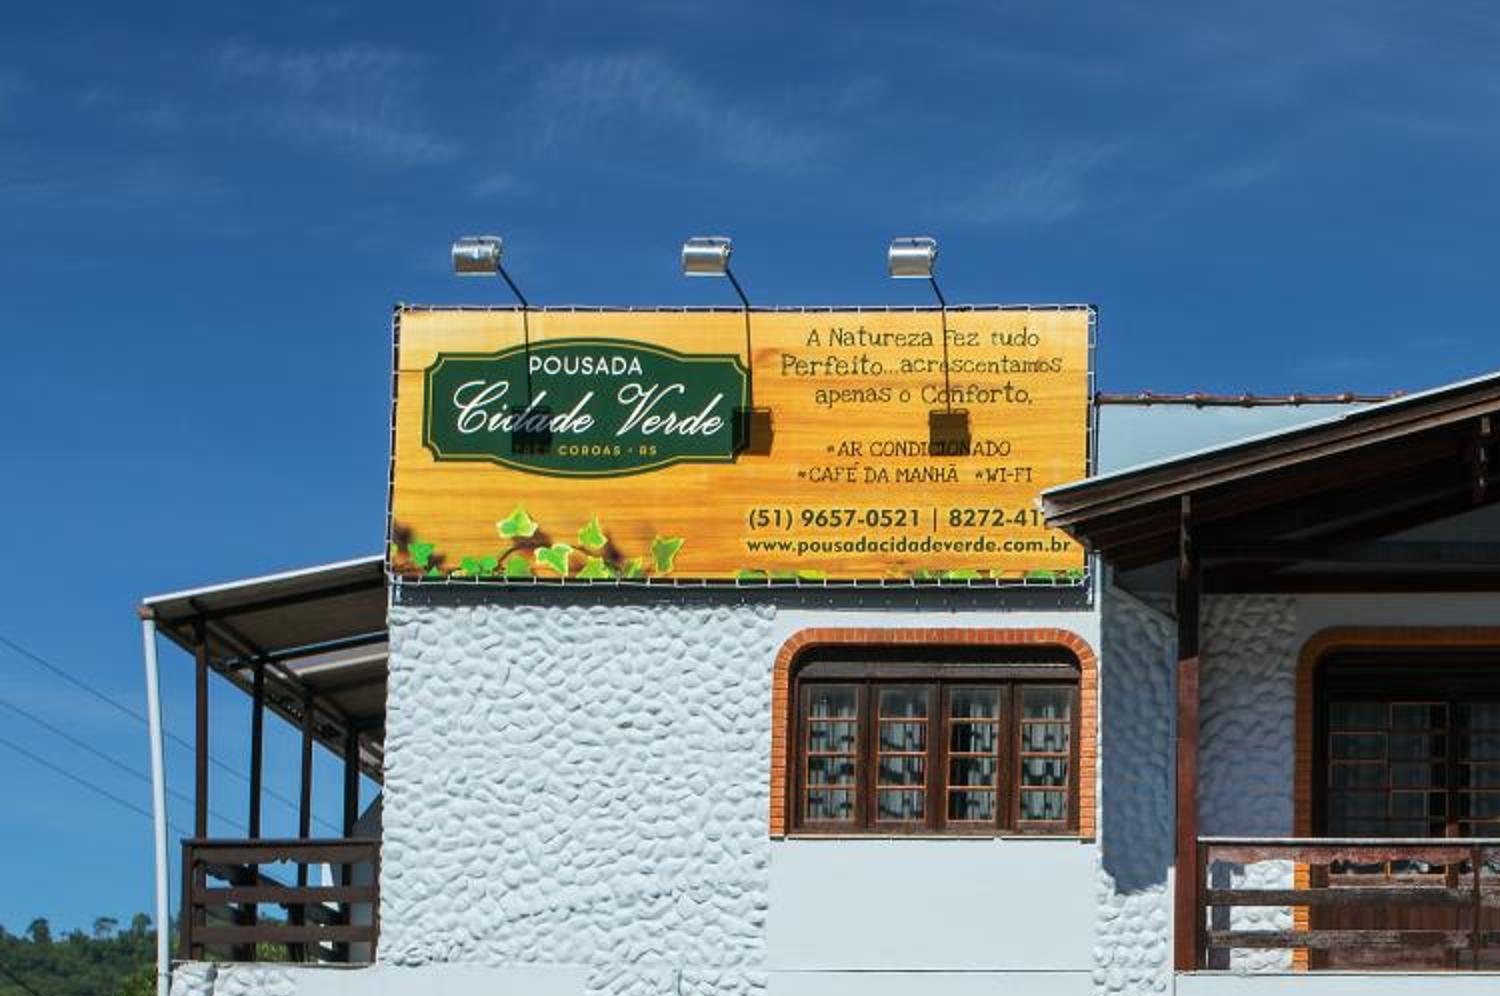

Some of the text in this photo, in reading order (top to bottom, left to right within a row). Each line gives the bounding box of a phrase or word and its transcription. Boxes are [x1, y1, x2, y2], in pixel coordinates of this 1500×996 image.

[806, 327, 821, 346] A
[828, 325, 934, 347] Natureza
[990, 327, 1041, 347] tudo
[529, 355, 643, 376] POUSADA
[452, 379, 724, 437] Cidade Verde
[815, 387, 893, 409] apenas
[899, 390, 911, 404] o
[558, 444, 621, 456] COROAS
[869, 440, 1011, 458] CONDICIONADO
[864, 466, 889, 483] DA
[895, 464, 959, 483] MANHÃ
[748, 508, 793, 531] (51)
[801, 508, 920, 528] 9657-0521
[746, 535, 1071, 556] www.pousadacidadeverde.com.br
